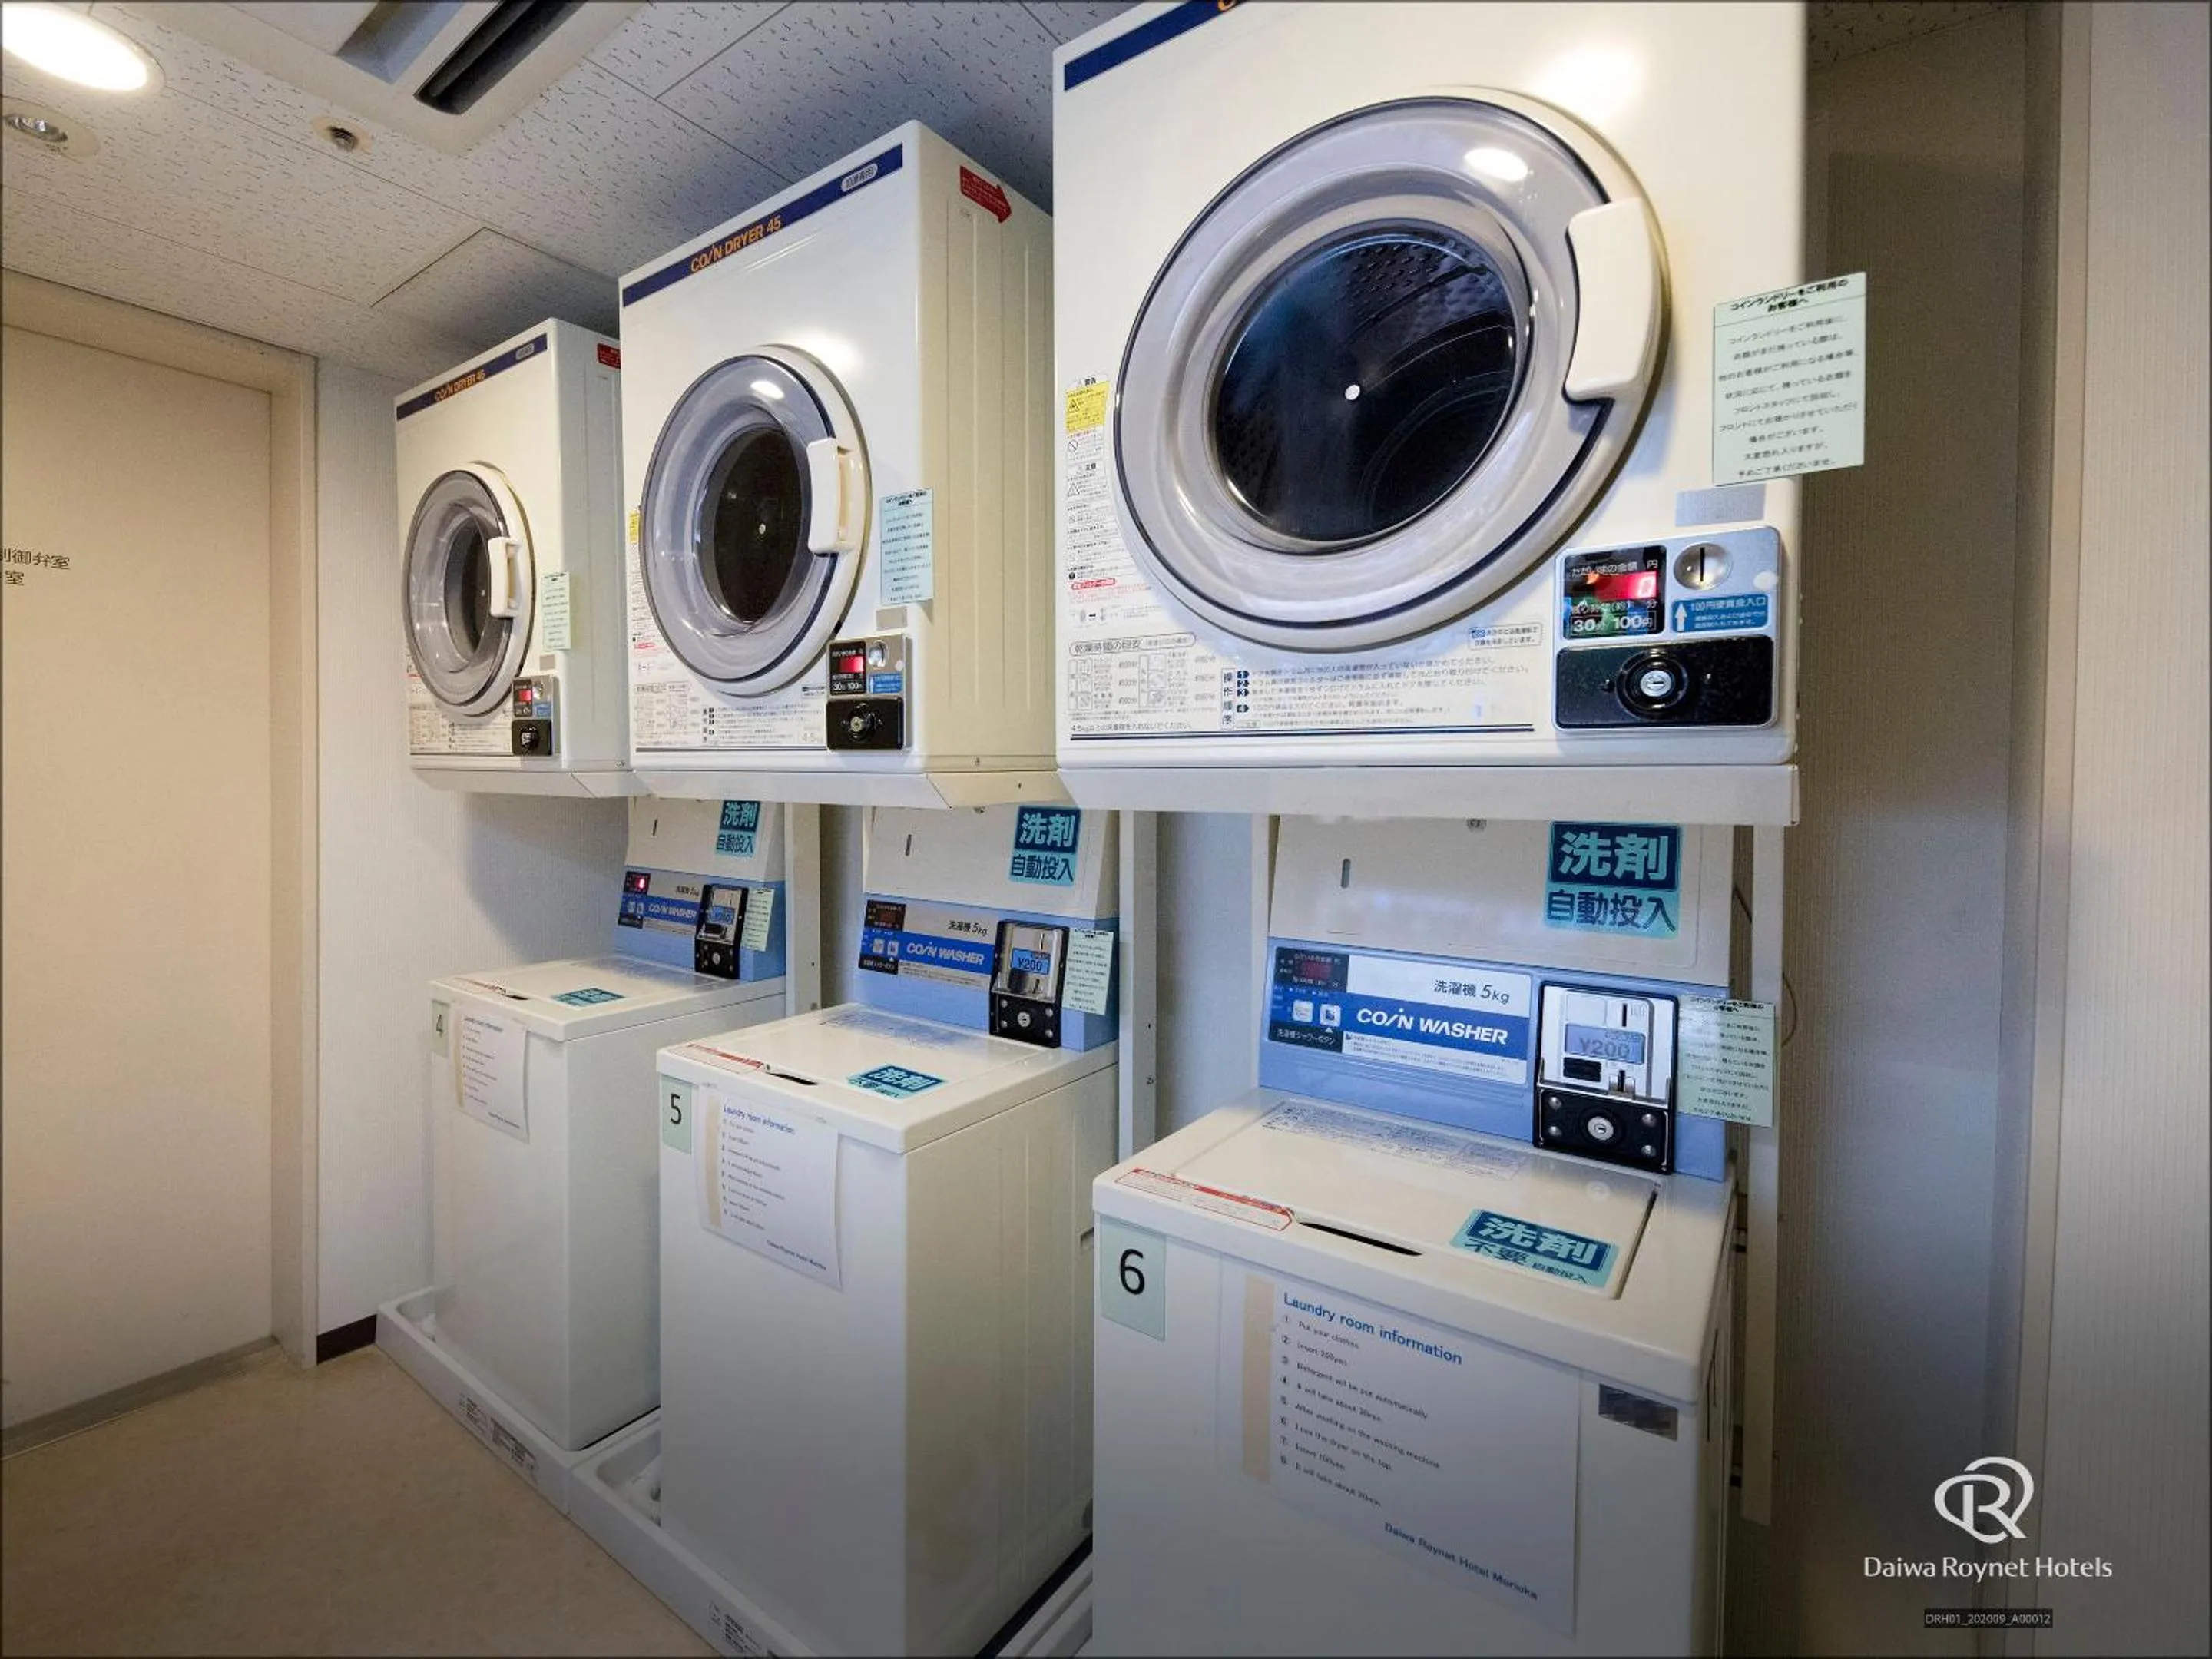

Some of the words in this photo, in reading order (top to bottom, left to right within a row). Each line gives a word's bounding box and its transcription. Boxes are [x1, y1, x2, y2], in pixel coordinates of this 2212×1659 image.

[724, 224, 765, 257] DRYER
[766, 214, 783, 234] 45
[1020, 813, 1076, 847] 洗剤
[1010, 854, 1075, 882] 自動投入
[1558, 830, 1670, 881] 洗剤
[1547, 888, 1677, 932] 自動投入
[939, 948, 985, 965] WASHER
[1433, 979, 1476, 998] 洗濯機
[1480, 984, 1511, 1005] 5kg
[1419, 1018, 1508, 1045] WASHER
[669, 1093, 683, 1125] 5
[1478, 1217, 1598, 1266] 洗剤
[1118, 1248, 1146, 1296] 6
[1283, 1292, 1336, 1322] Laundry
[1339, 1314, 1375, 1335] room
[1379, 1324, 1463, 1366] information
[1459, 1555, 1490, 1580] Hotel
